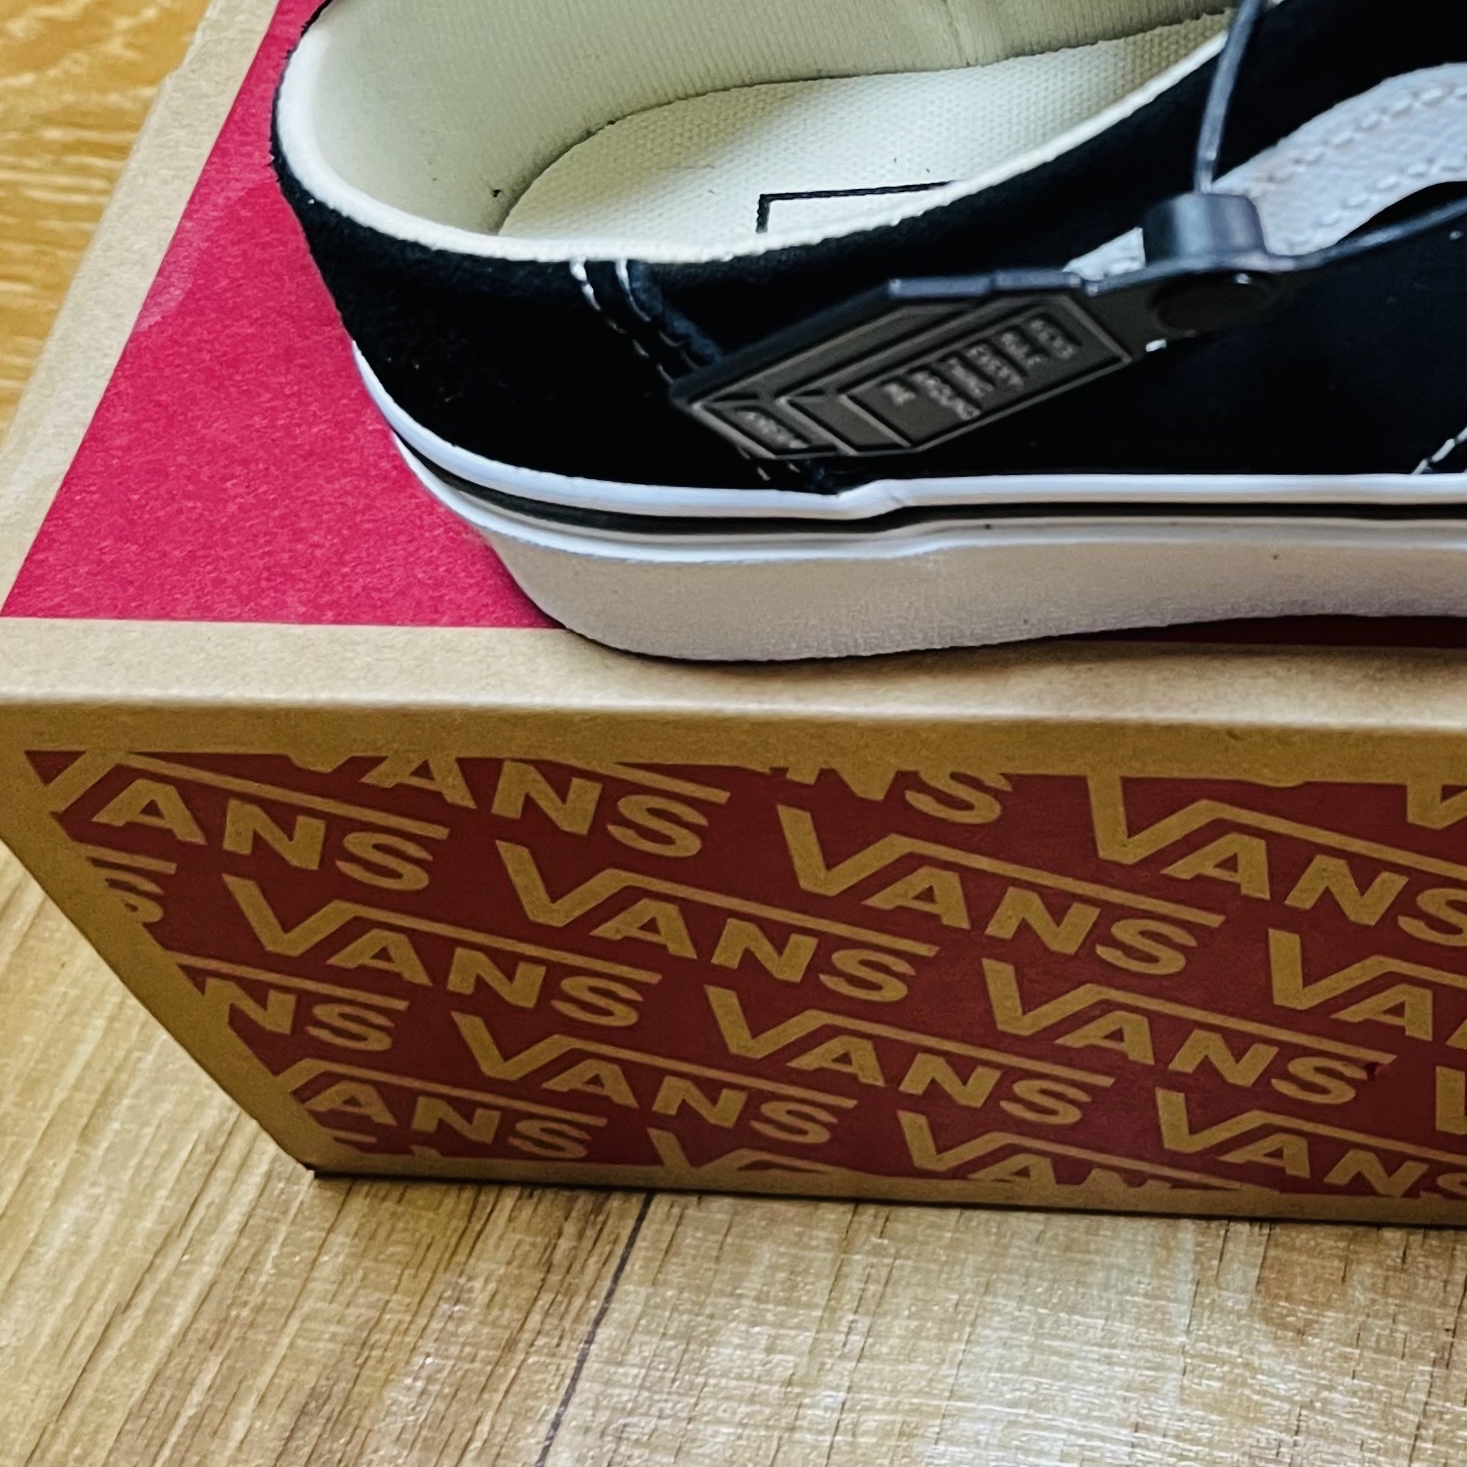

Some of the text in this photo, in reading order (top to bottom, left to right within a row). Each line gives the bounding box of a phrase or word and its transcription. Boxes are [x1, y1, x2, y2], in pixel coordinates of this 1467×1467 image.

[285, 752, 731, 858] ANS
[222, 872, 662, 1027] VANS
[497, 838, 938, 1002] VANS
[777, 804, 1226, 975] VANS
[453, 1011, 857, 1144] VANS
[704, 985, 1116, 1125] VANS
[981, 958, 1397, 1104] VANS
